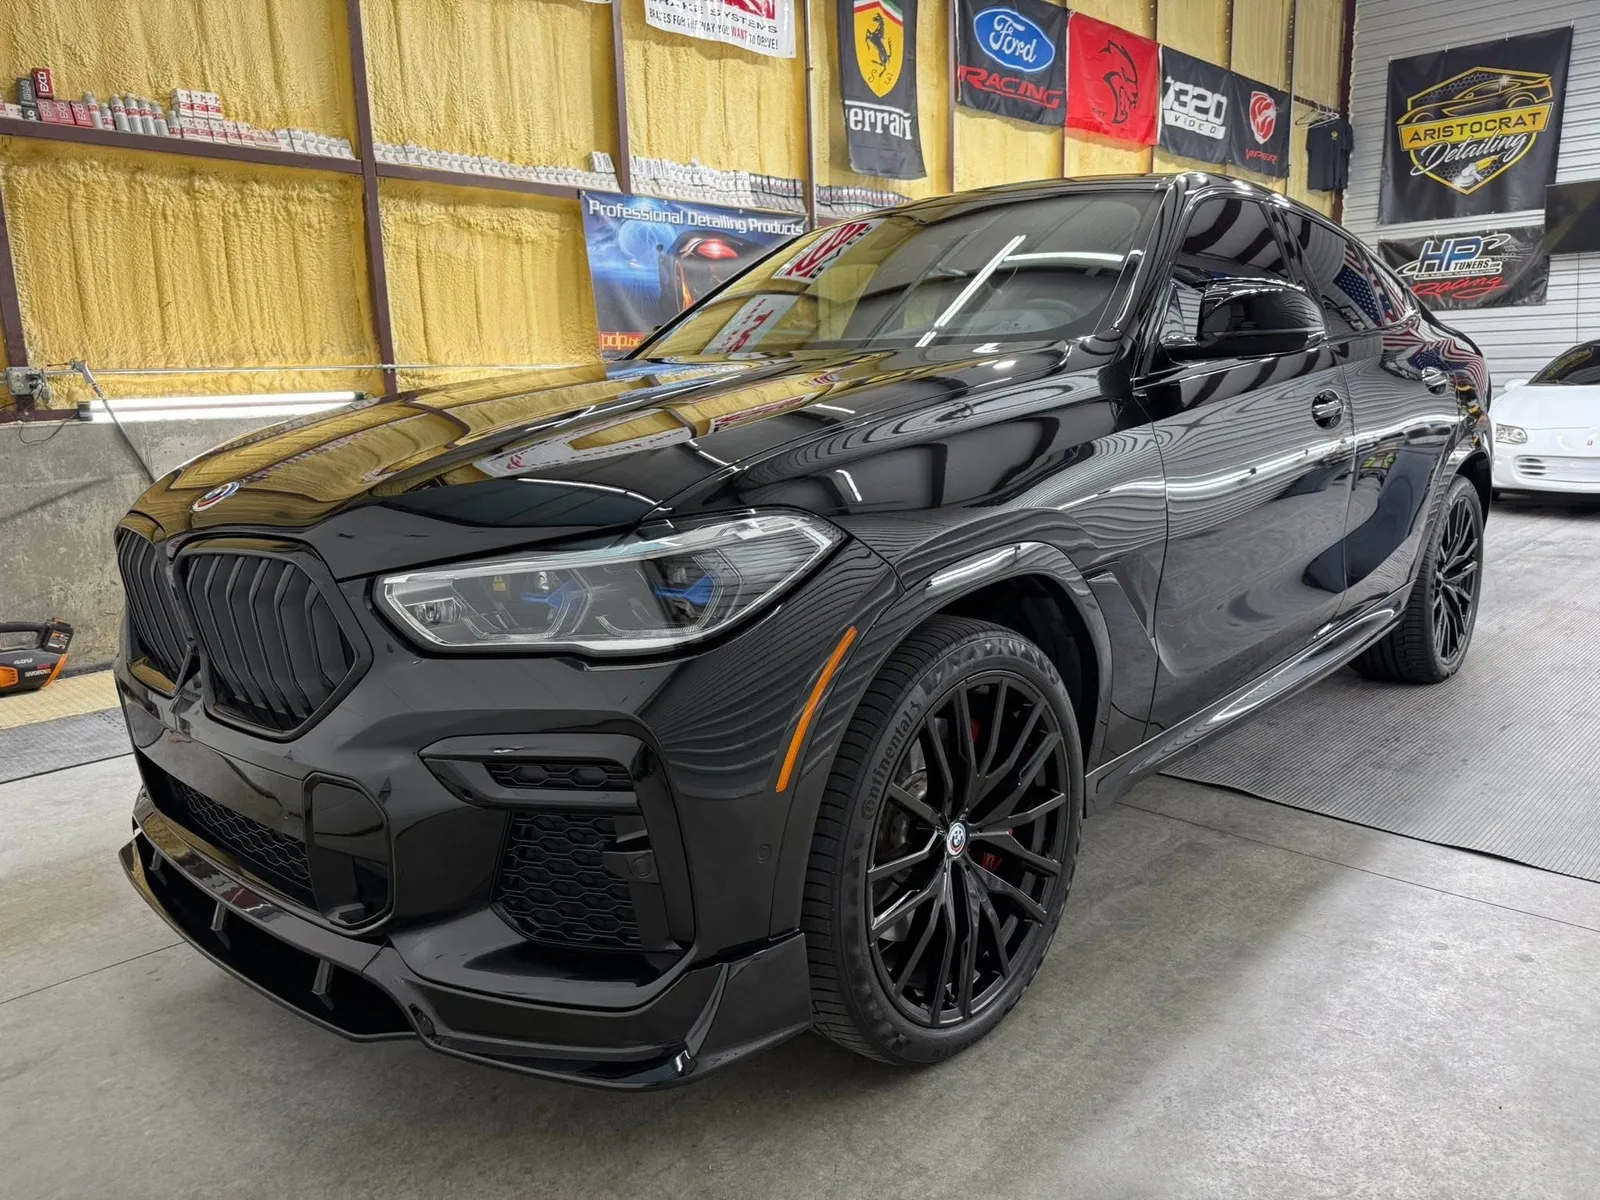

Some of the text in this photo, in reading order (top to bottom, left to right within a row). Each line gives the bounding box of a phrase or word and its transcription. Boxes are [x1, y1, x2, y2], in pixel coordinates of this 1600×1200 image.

[731, 26, 748, 43] WANT
[989, 15, 1037, 63] Ford
[958, 65, 1063, 109] RACING
[1174, 114, 1218, 134] VIDEO
[1409, 112, 1541, 143] ARISTOCRAT
[1245, 148, 1278, 165] VIPER
[1410, 129, 1529, 176] Detailing
[588, 199, 804, 236] Professional Detailing Products
[1418, 236, 1483, 273] HP
[1411, 275, 1508, 299] Racing
[862, 710, 914, 821] Continental
